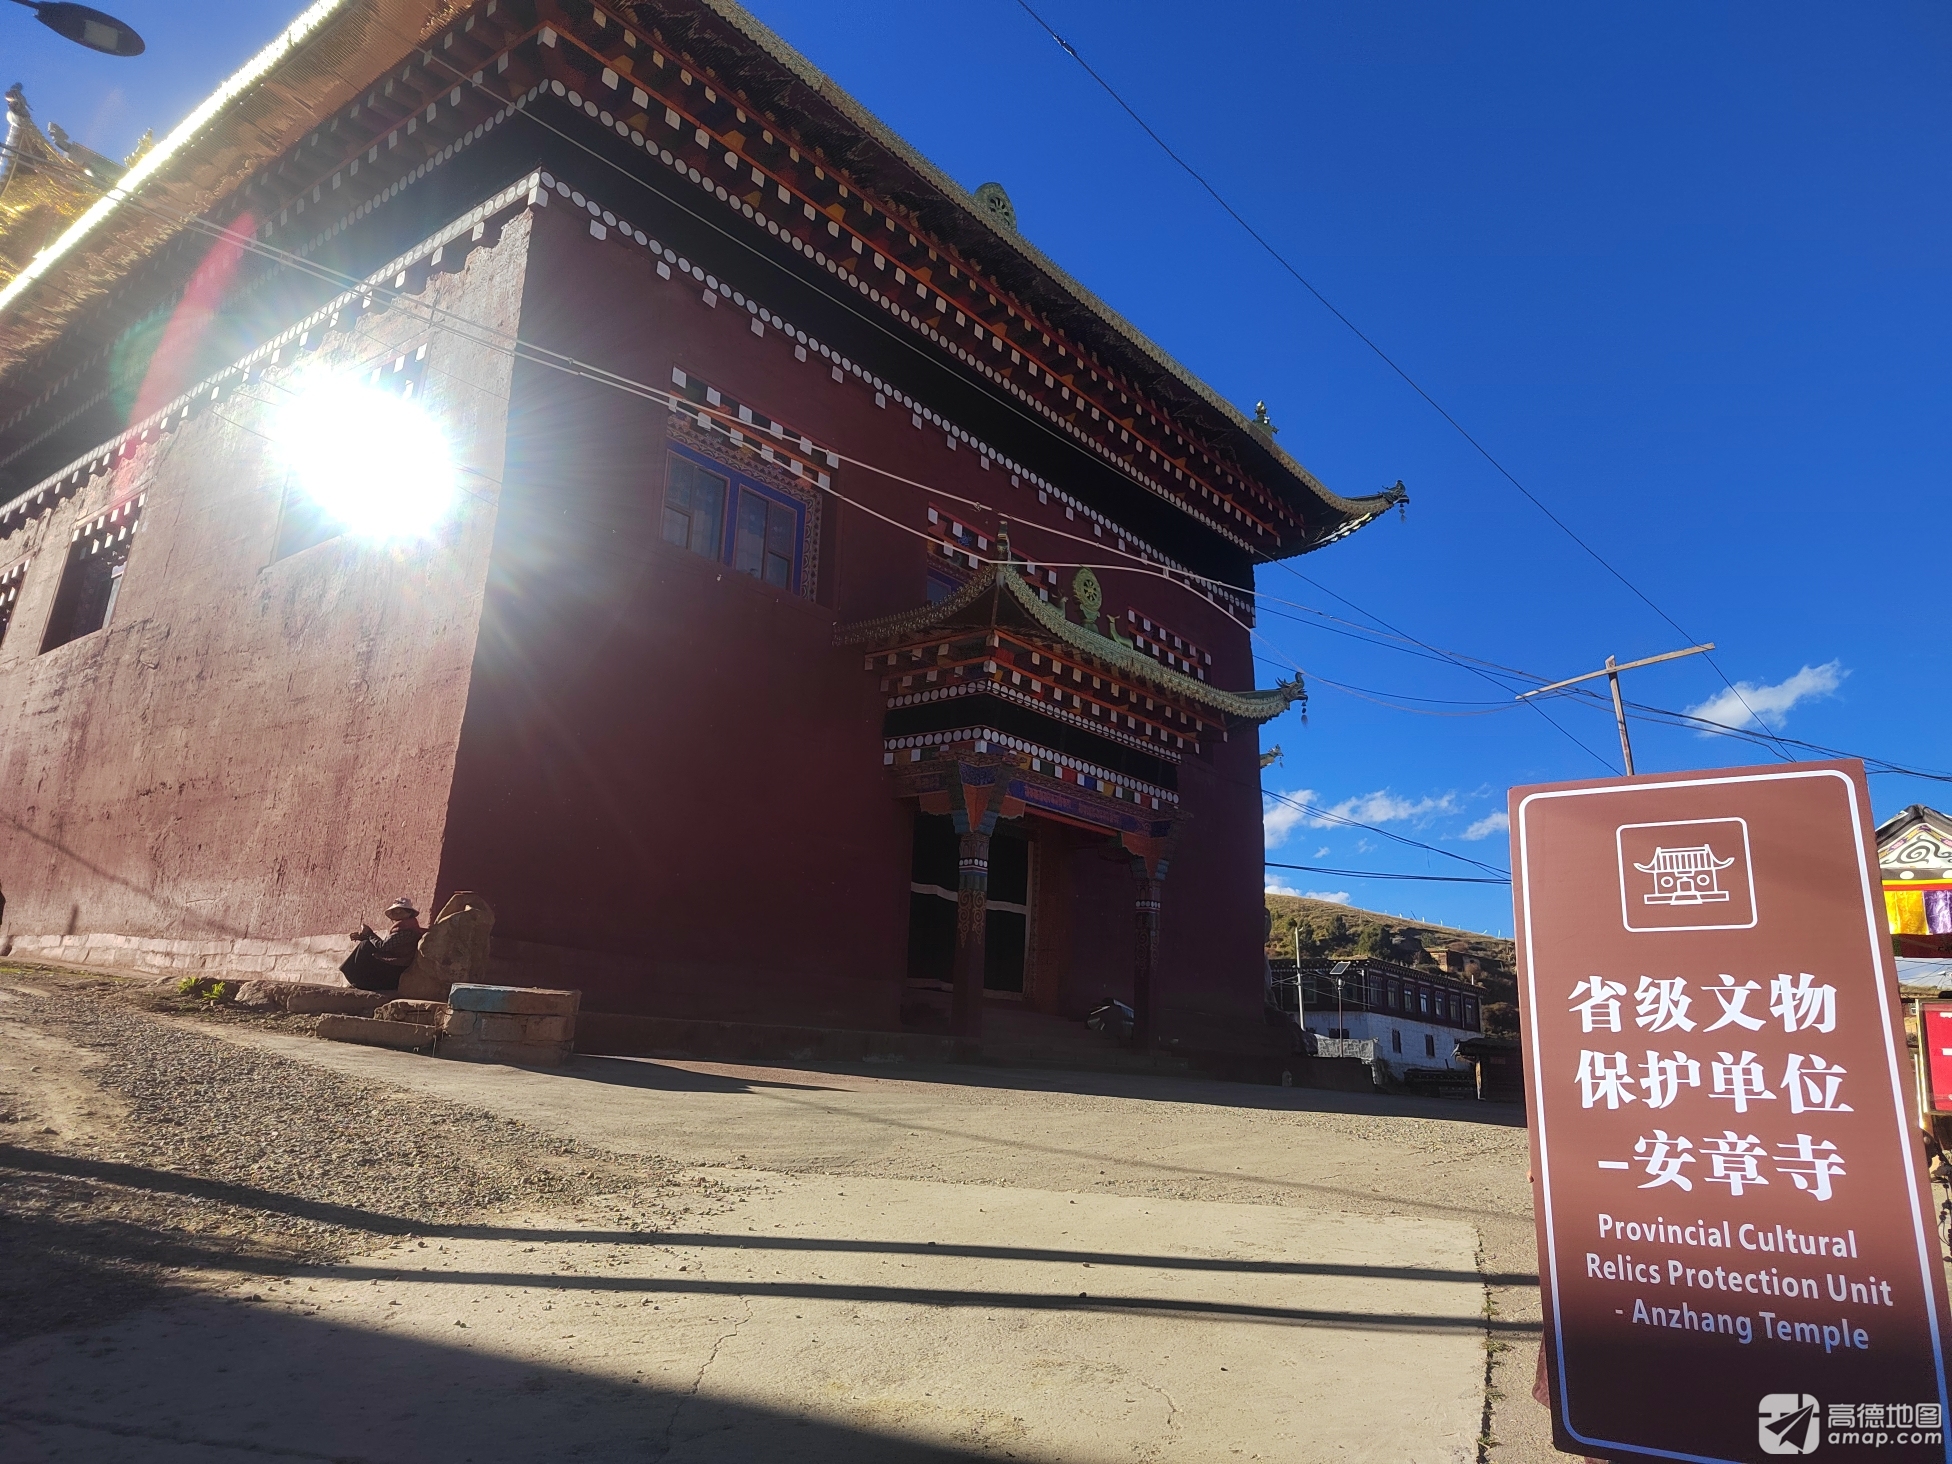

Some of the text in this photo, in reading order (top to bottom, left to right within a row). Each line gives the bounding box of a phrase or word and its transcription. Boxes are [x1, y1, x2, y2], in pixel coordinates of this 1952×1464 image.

[1567, 973, 1837, 1034] 省级文物
[1574, 1049, 1854, 1114] 保护单位
[1598, 1213, 1858, 1259] Provincial Cultural
[1586, 1252, 1894, 1306] Relics Protection Unit
[1632, 1298, 1753, 1344] Anzhang
[1759, 1311, 1869, 1353] Temple
